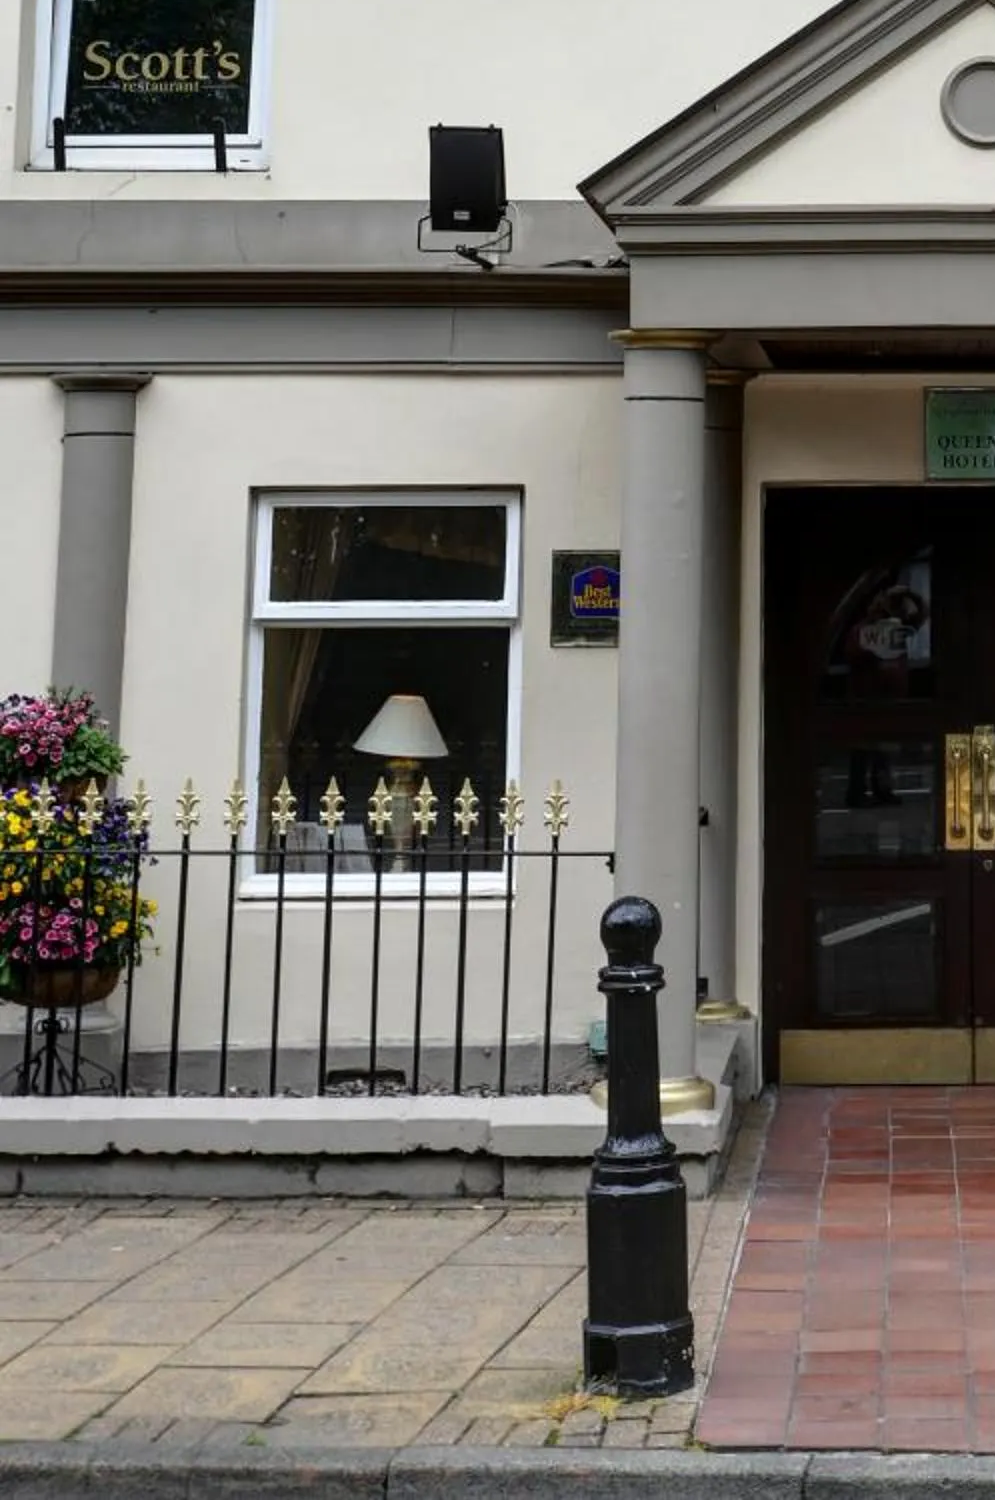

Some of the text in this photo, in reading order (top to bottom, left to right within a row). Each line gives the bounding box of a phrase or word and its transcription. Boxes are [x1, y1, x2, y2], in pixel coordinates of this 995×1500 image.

[83, 40, 241, 81] Scott's
[121, 80, 200, 93] restaurant
[573, 595, 620, 609] Wester
